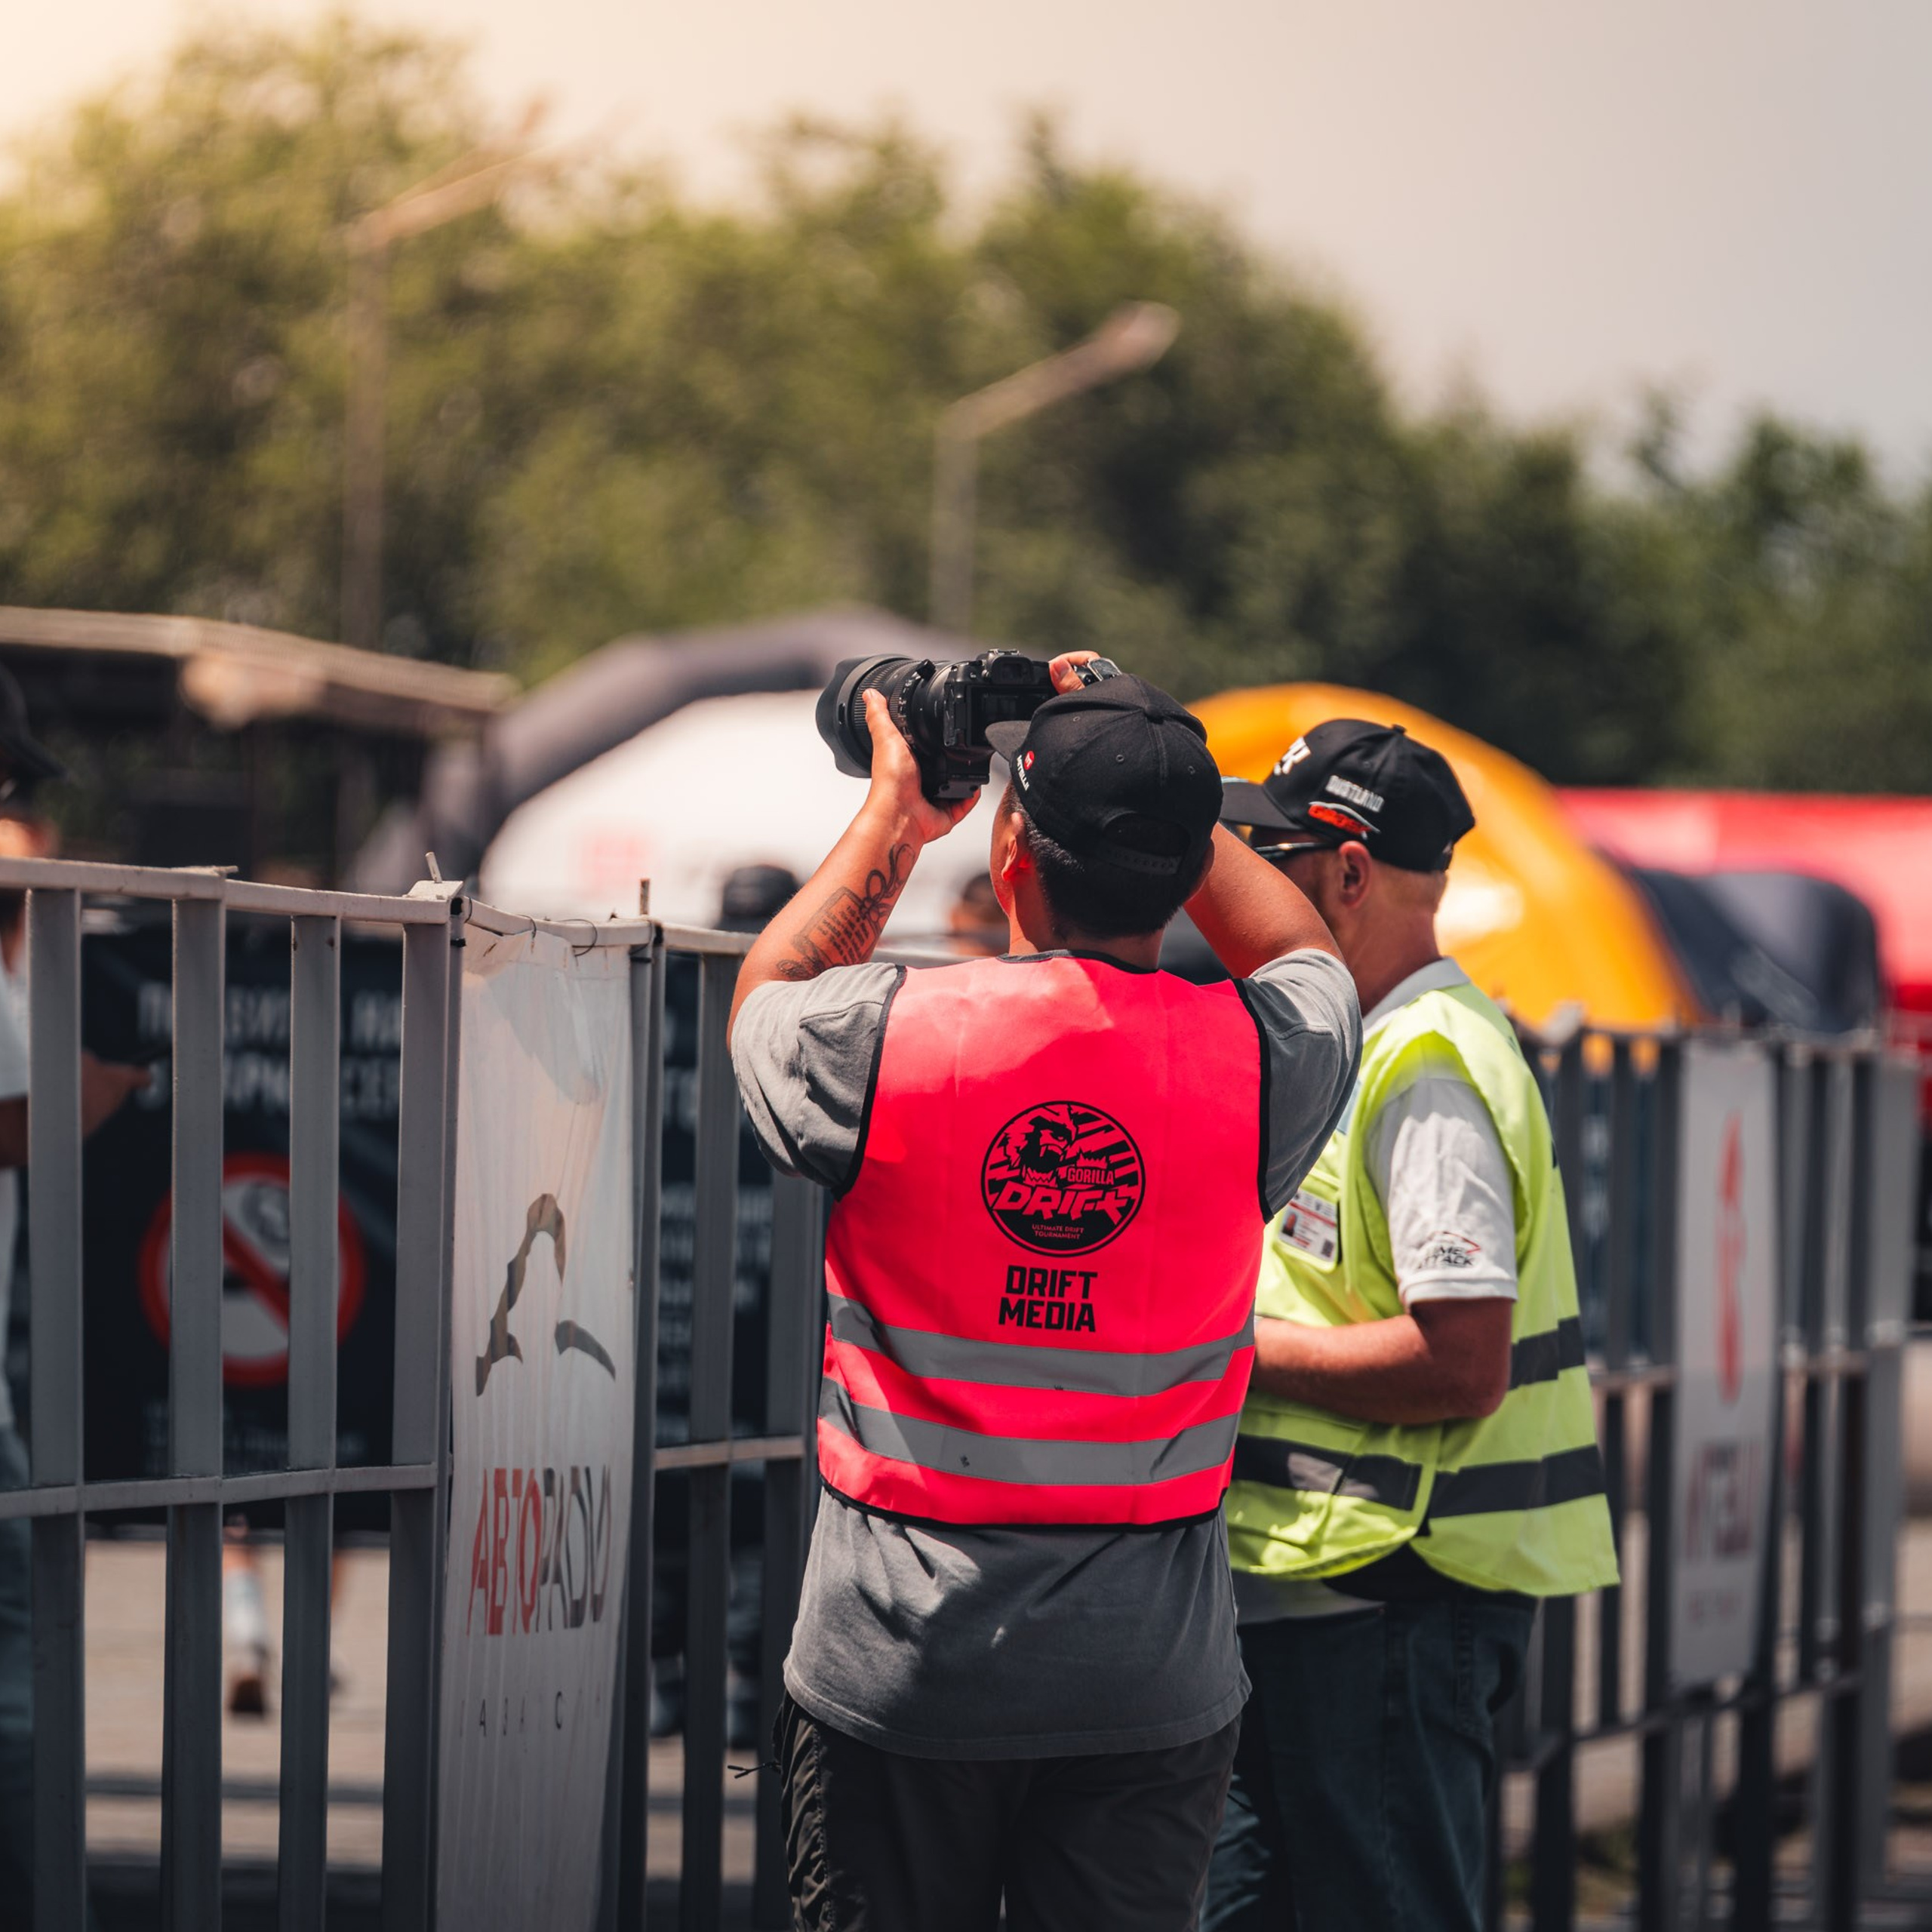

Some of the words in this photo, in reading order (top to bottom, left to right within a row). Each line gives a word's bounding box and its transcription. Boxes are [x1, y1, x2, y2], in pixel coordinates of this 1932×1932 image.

[1068, 1168, 1114, 1185] GORILLA
[992, 1180, 1129, 1225] DRIFT
[1035, 1231, 1081, 1239] TOURNAMENT
[1005, 1265, 1098, 1299] DRIFT
[998, 1297, 1096, 1332] MEDIA
